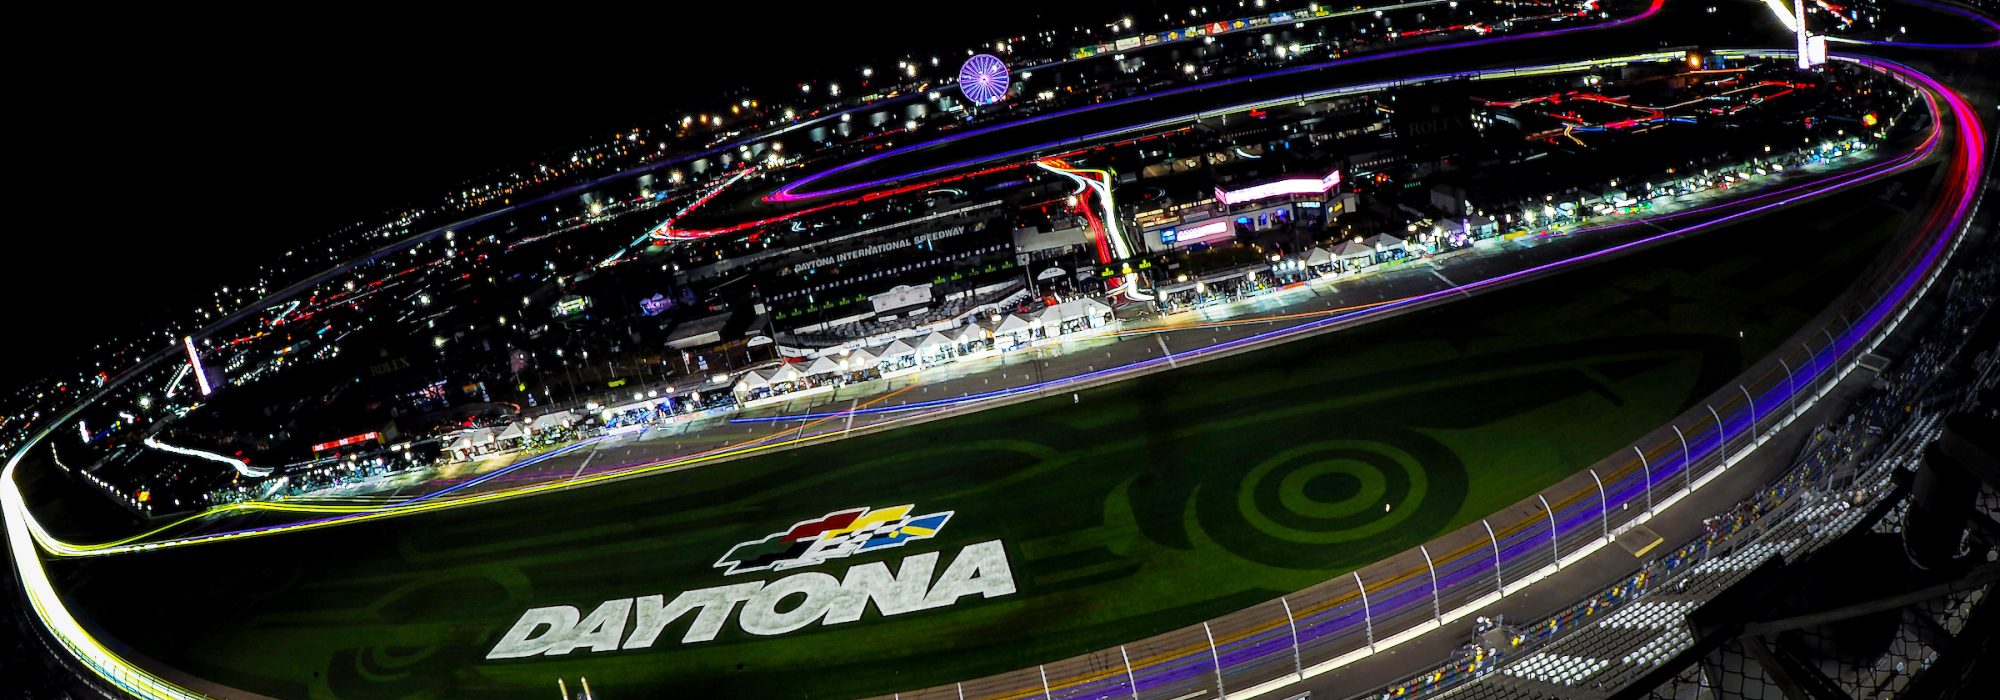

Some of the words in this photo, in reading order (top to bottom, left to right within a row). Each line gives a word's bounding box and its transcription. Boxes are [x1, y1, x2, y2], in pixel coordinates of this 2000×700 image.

[794, 255, 835, 273] DAYTONA
[836, 239, 911, 263] INTERNATIONAL
[913, 226, 965, 246] SPEEDWAY
[486, 539, 1017, 660] DAYTONA
